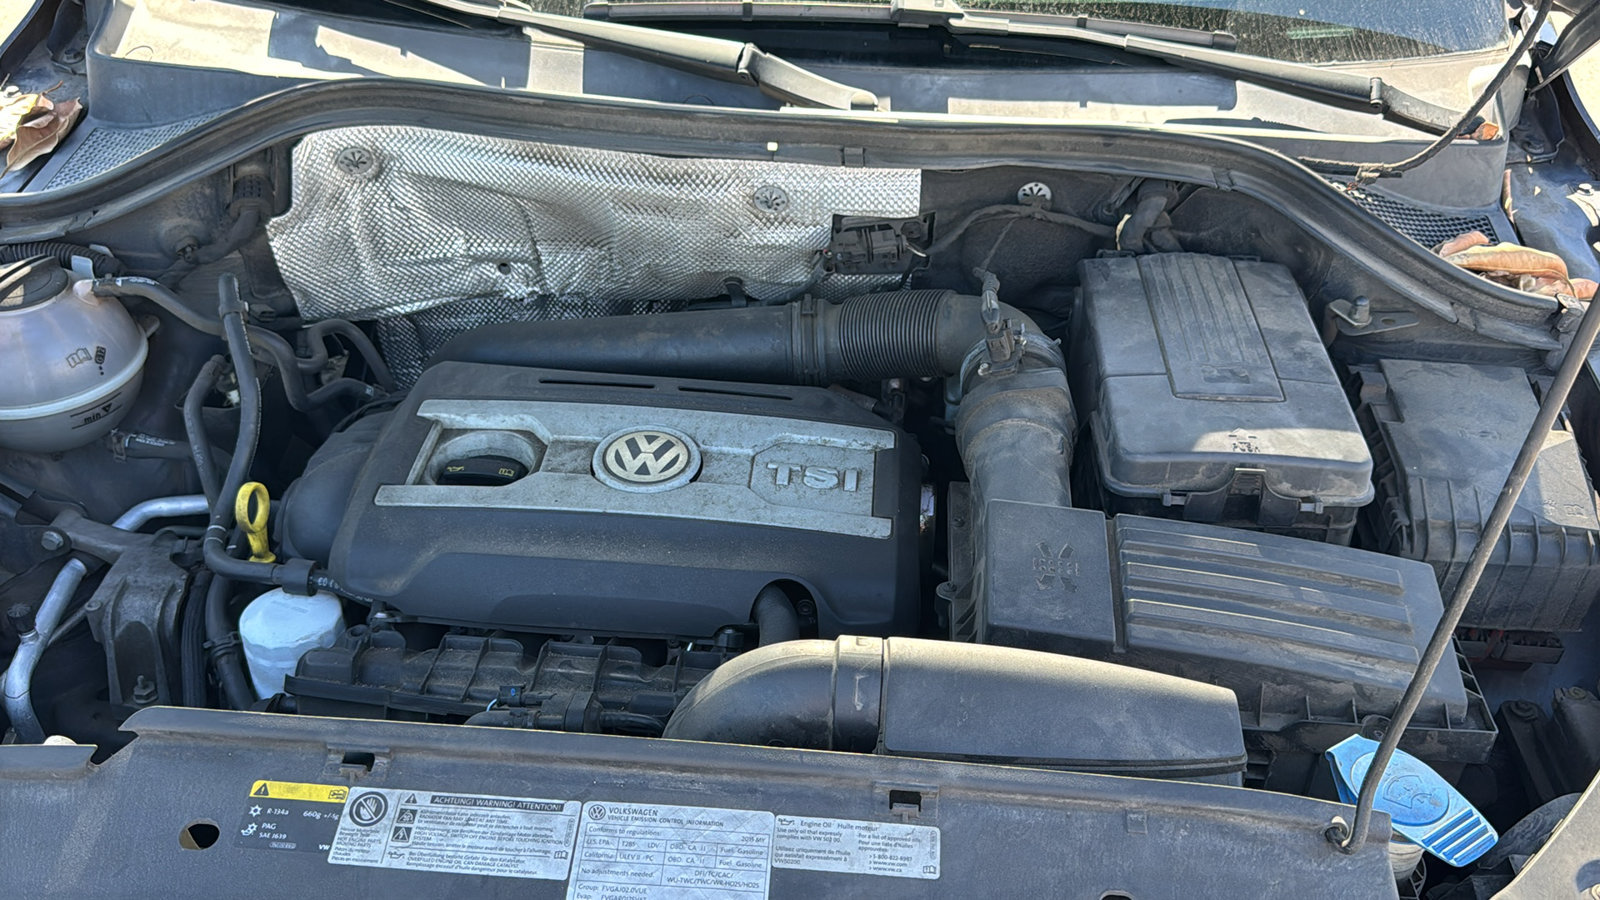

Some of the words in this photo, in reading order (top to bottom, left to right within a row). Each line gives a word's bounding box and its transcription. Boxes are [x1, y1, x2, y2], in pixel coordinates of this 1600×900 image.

[84, 413, 101, 425] min
[766, 463, 860, 492] TSI
[433, 796, 474, 806] ACHTUNG!
[476, 799, 516, 808] WARNING!
[516, 801, 561, 811] ATTENTION!
[267, 808, 289, 816] R-134a
[303, 810, 322, 820] 660g
[609, 807, 658, 816] VOLKSWAGEN
[659, 817, 684, 825] CONTROL
[686, 818, 724, 827] INFORMATION
[800, 820, 822, 828] Engine
[589, 826, 618, 834] Conforms
[737, 848, 764, 856] Gasoline
[736, 860, 762, 868] Gasoline
[591, 869, 629, 877] adjustments
